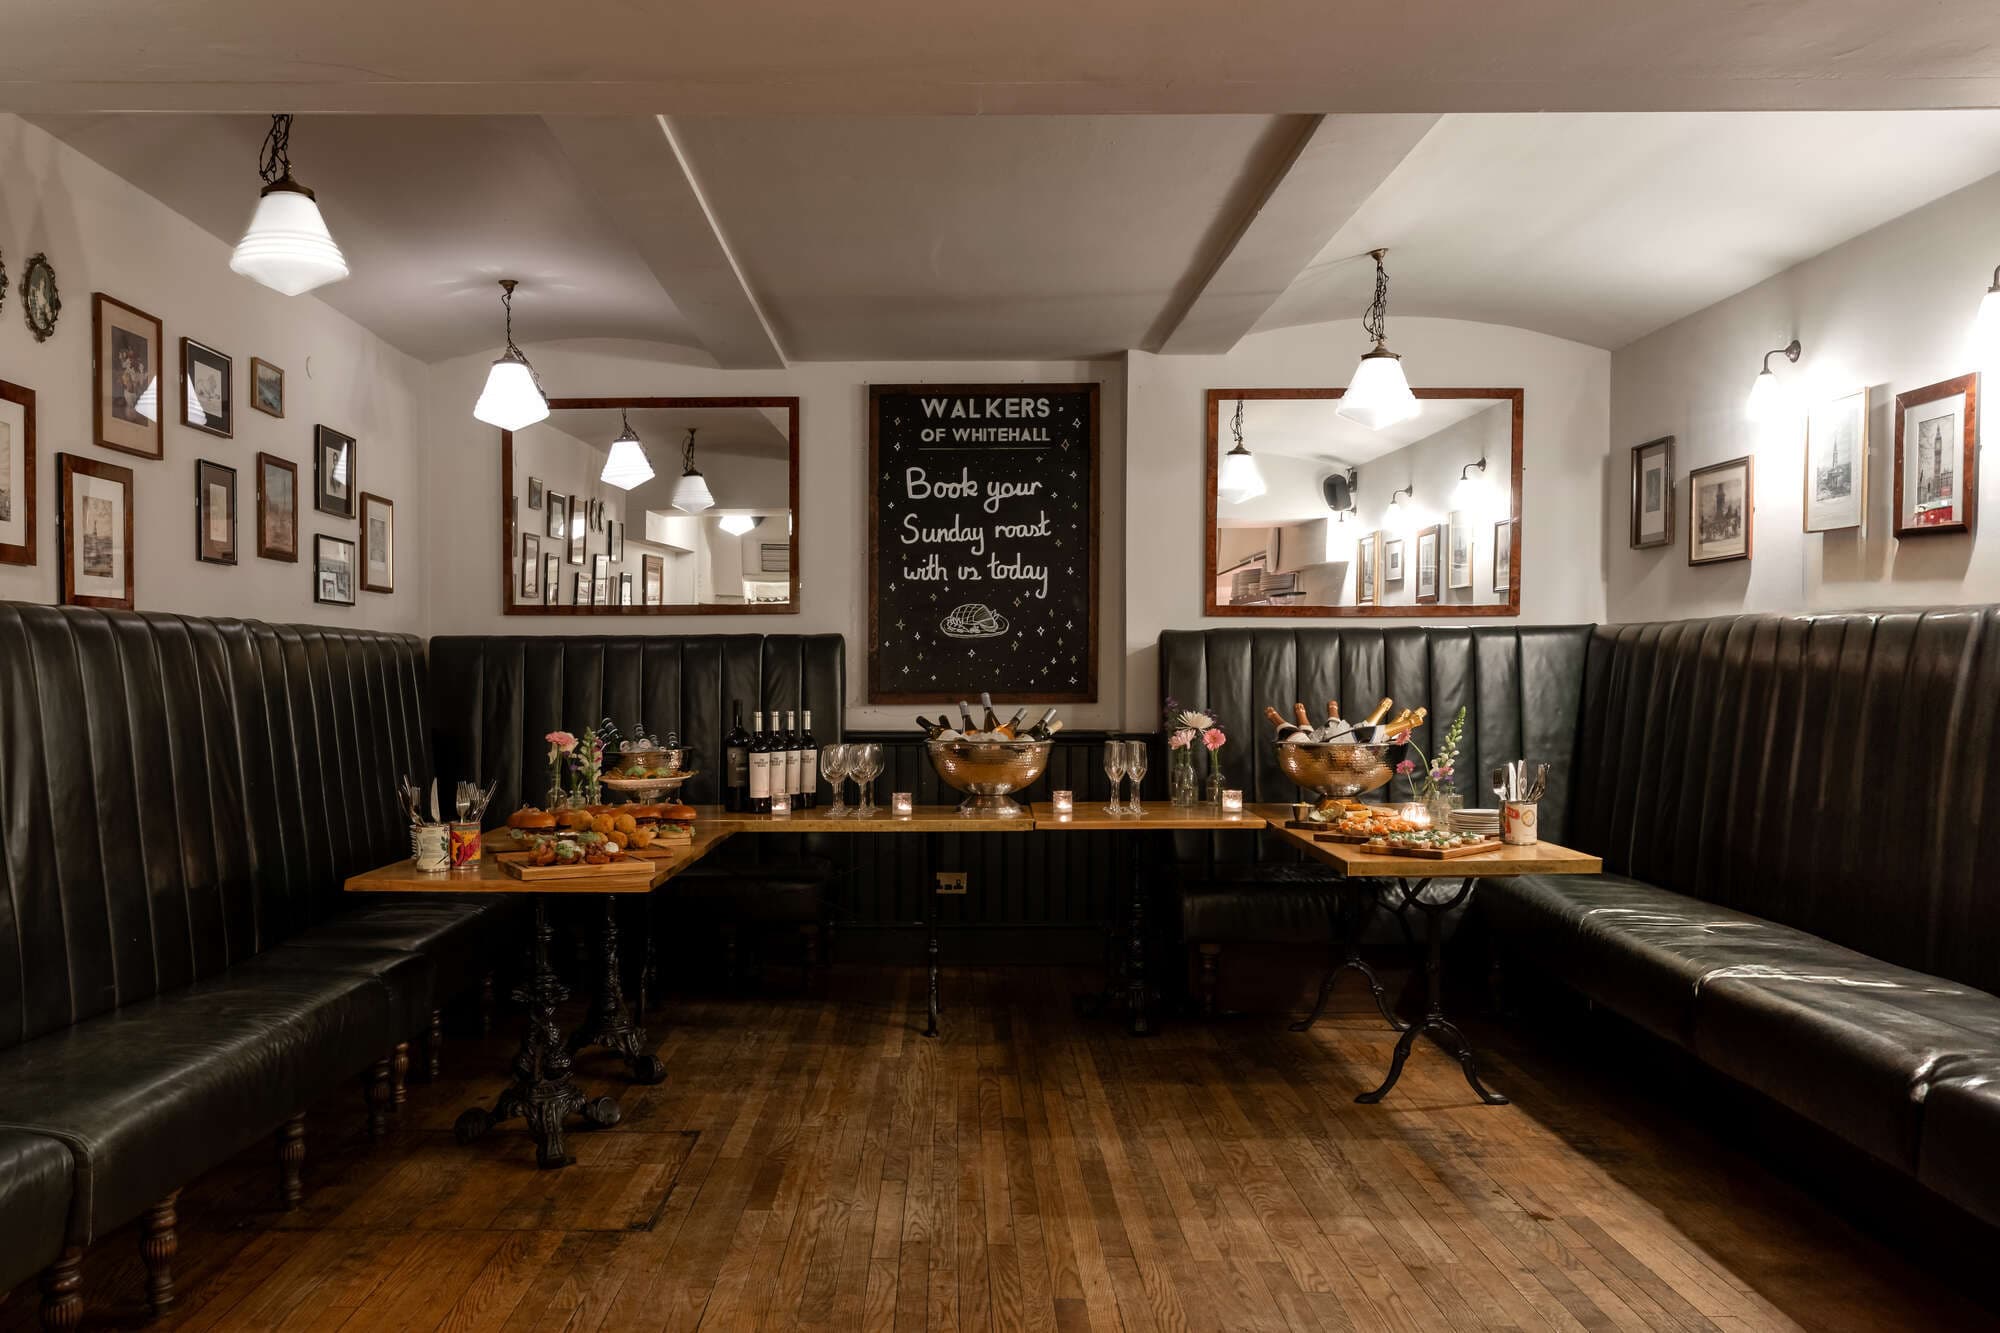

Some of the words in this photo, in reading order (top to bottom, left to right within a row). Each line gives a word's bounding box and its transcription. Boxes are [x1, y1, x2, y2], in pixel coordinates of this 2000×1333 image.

[920, 398, 1050, 418] WALKERS
[920, 428, 946, 442] OF
[952, 428, 1050, 442] WHITEHALL
[906, 466, 978, 499] Book
[984, 480, 1043, 513] your
[900, 513, 985, 555] Sunday
[995, 511, 1052, 537] roast
[903, 554, 948, 581] with
[957, 563, 982, 580] us
[987, 552, 1048, 599] today
